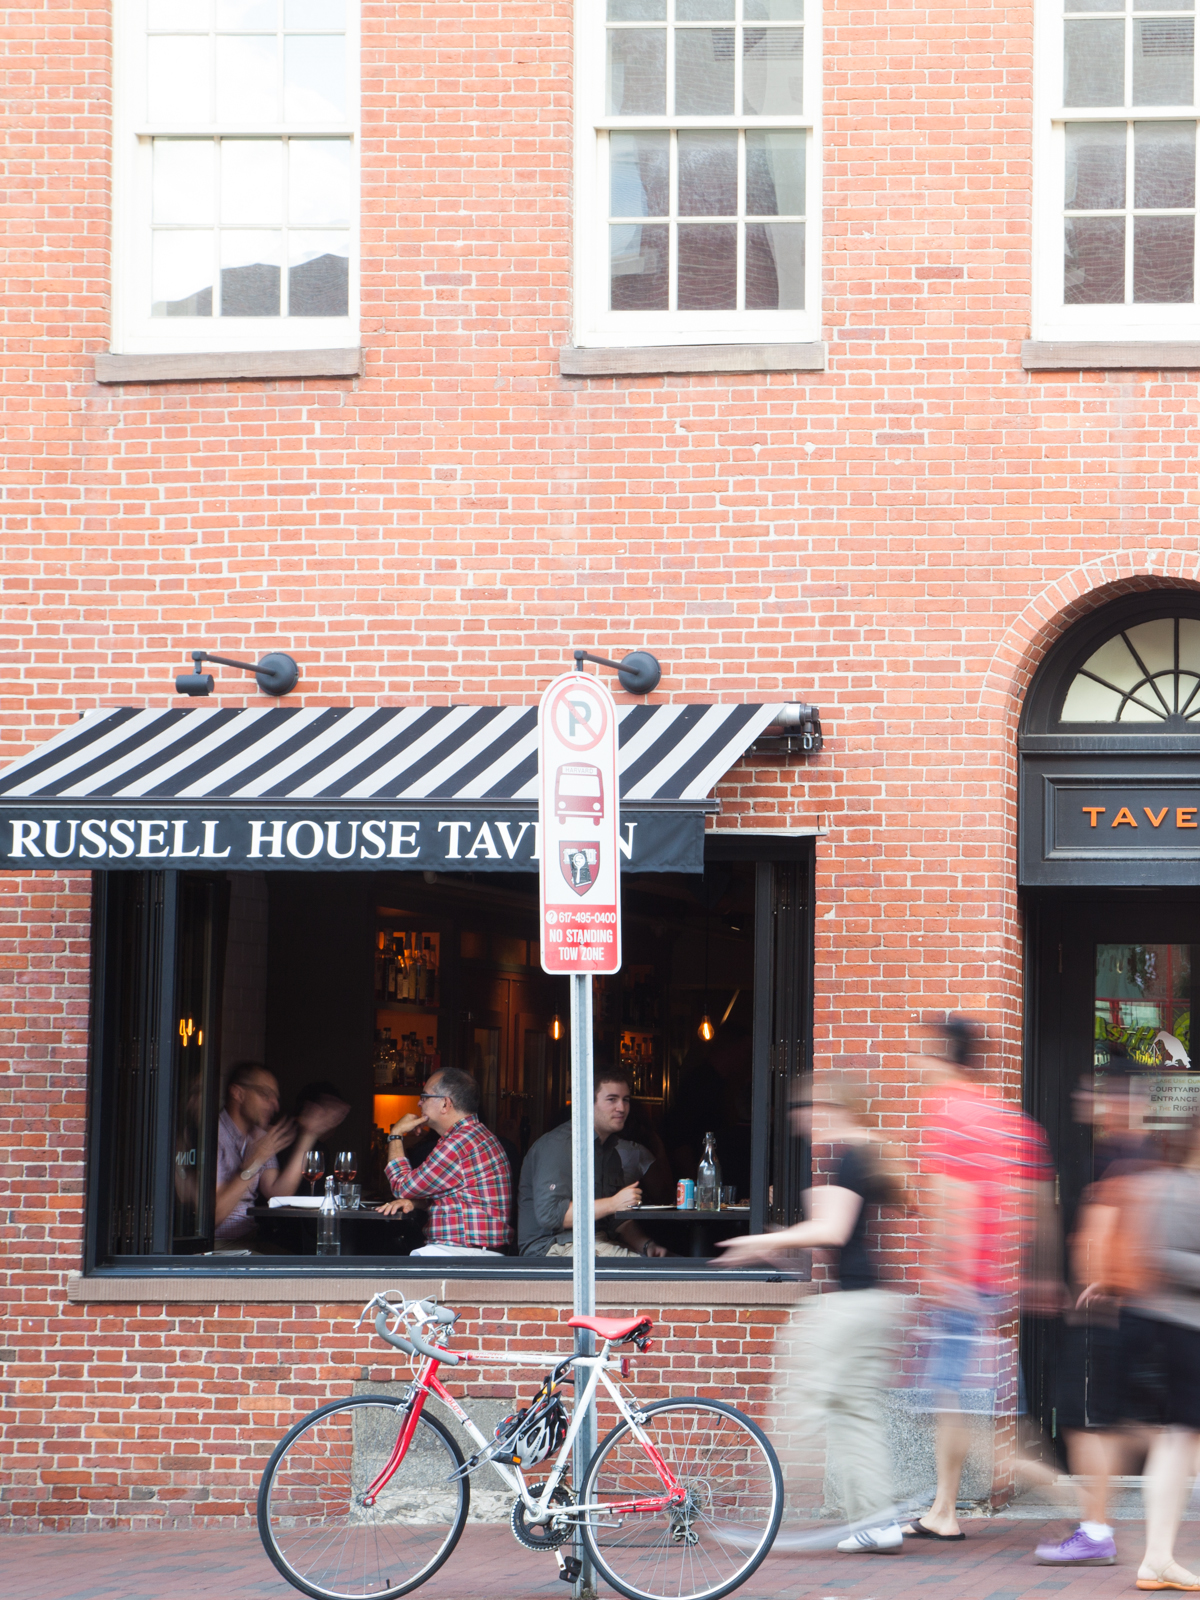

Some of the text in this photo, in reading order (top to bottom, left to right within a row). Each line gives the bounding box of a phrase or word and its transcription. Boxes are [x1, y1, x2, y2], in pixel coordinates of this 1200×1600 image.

[565, 767, 594, 775] HARVARD
[8, 818, 231, 858] RUSSELL
[246, 819, 421, 860] HOUSE
[437, 820, 638, 860] TAVN
[558, 911, 616, 924] 617-495-0400
[549, 929, 614, 943] NO STANDING
[558, 947, 605, 961] TOW ZONE
[1150, 1094, 1198, 1103] ENTRANCE
[1172, 1104, 1199, 1112] RIGHT
